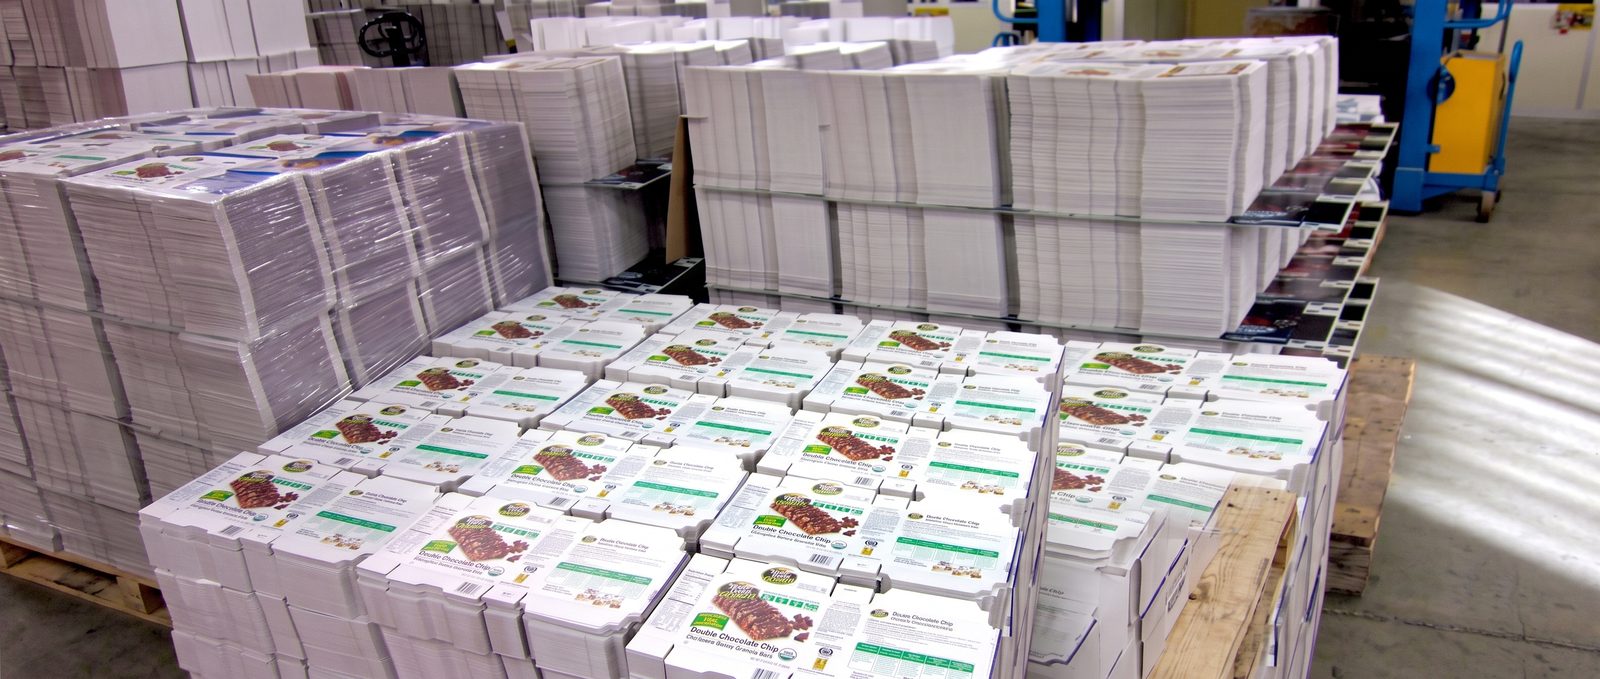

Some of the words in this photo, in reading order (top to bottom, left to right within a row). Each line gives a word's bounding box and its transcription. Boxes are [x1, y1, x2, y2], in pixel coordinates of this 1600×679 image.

[1057, 491, 1076, 499] Chip
[752, 524, 777, 533] Double
[778, 527, 814, 540] Chocolate
[814, 535, 831, 544] Chip
[441, 555, 475, 567] Chocolate
[475, 562, 491, 570] Chip
[690, 626, 718, 638] Double
[718, 633, 759, 648] Chocolate
[760, 642, 779, 653] Chip
[735, 645, 758, 656] Granola
